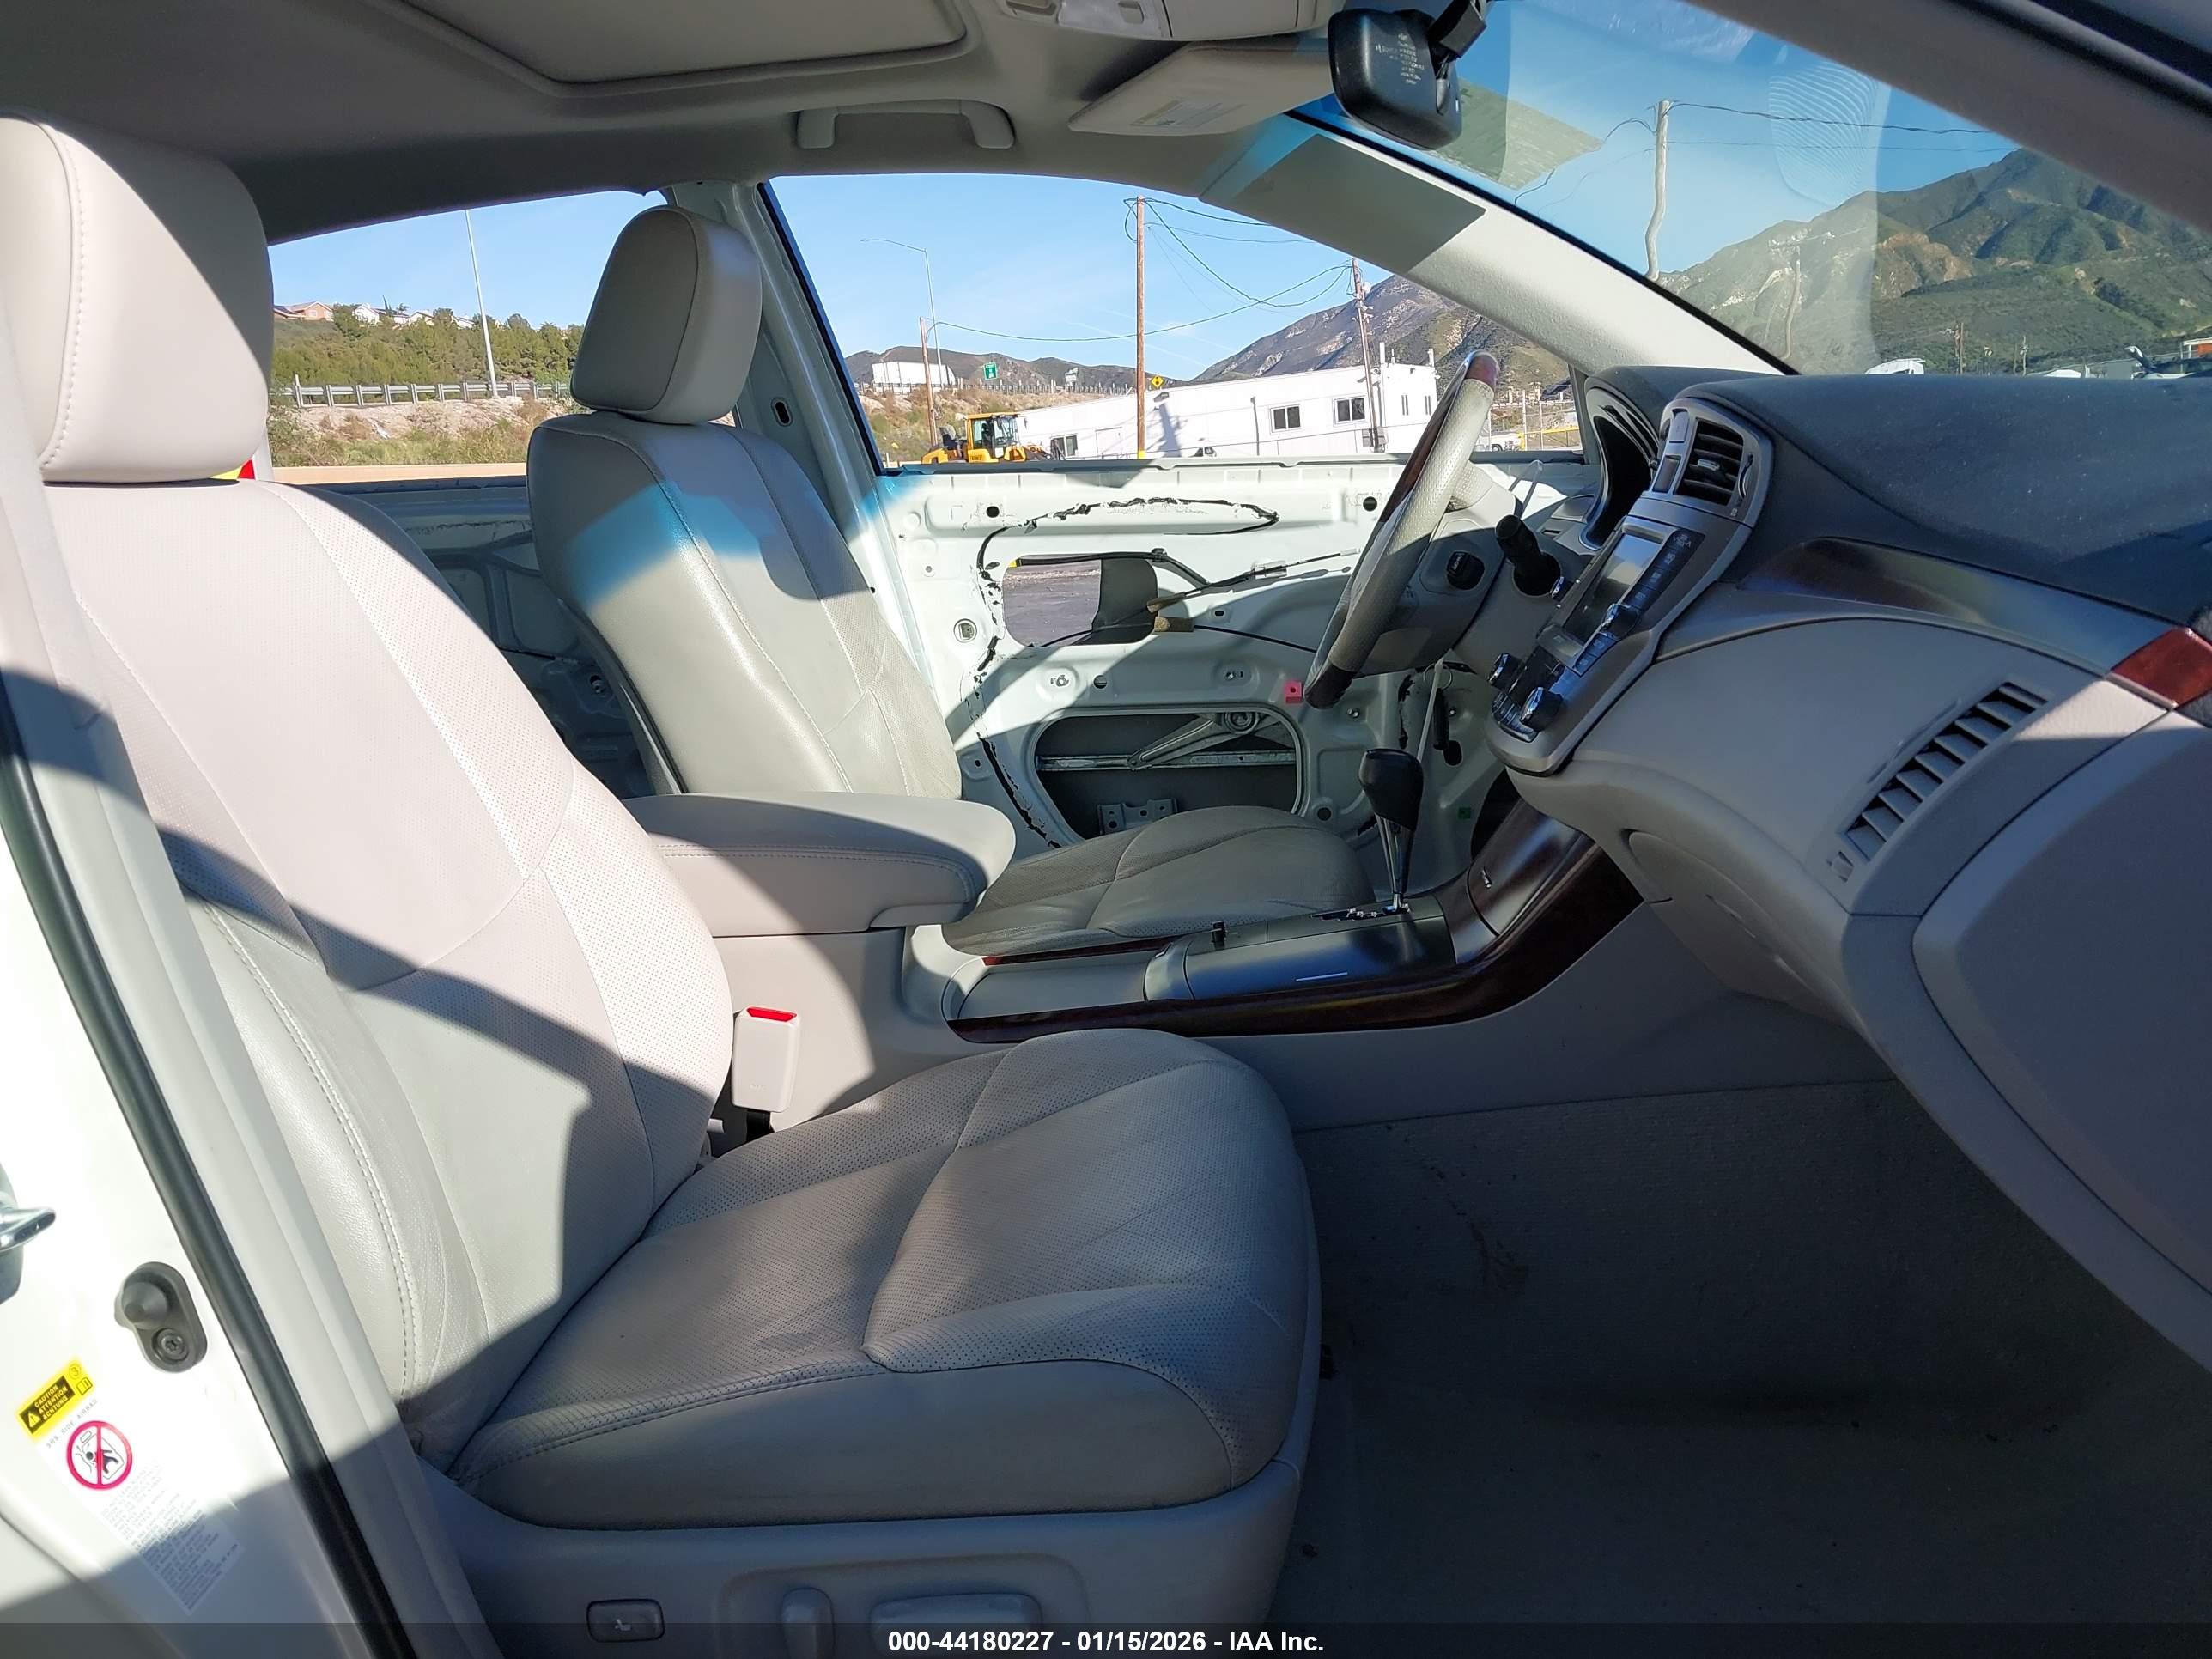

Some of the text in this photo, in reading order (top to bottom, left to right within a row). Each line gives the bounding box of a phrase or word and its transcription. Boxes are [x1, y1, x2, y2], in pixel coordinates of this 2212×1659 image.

[34, 1384, 58, 1408] CAUTION
[38, 1386, 68, 1414] ATTENTION
[42, 1395, 69, 1420] ACHTUNG
